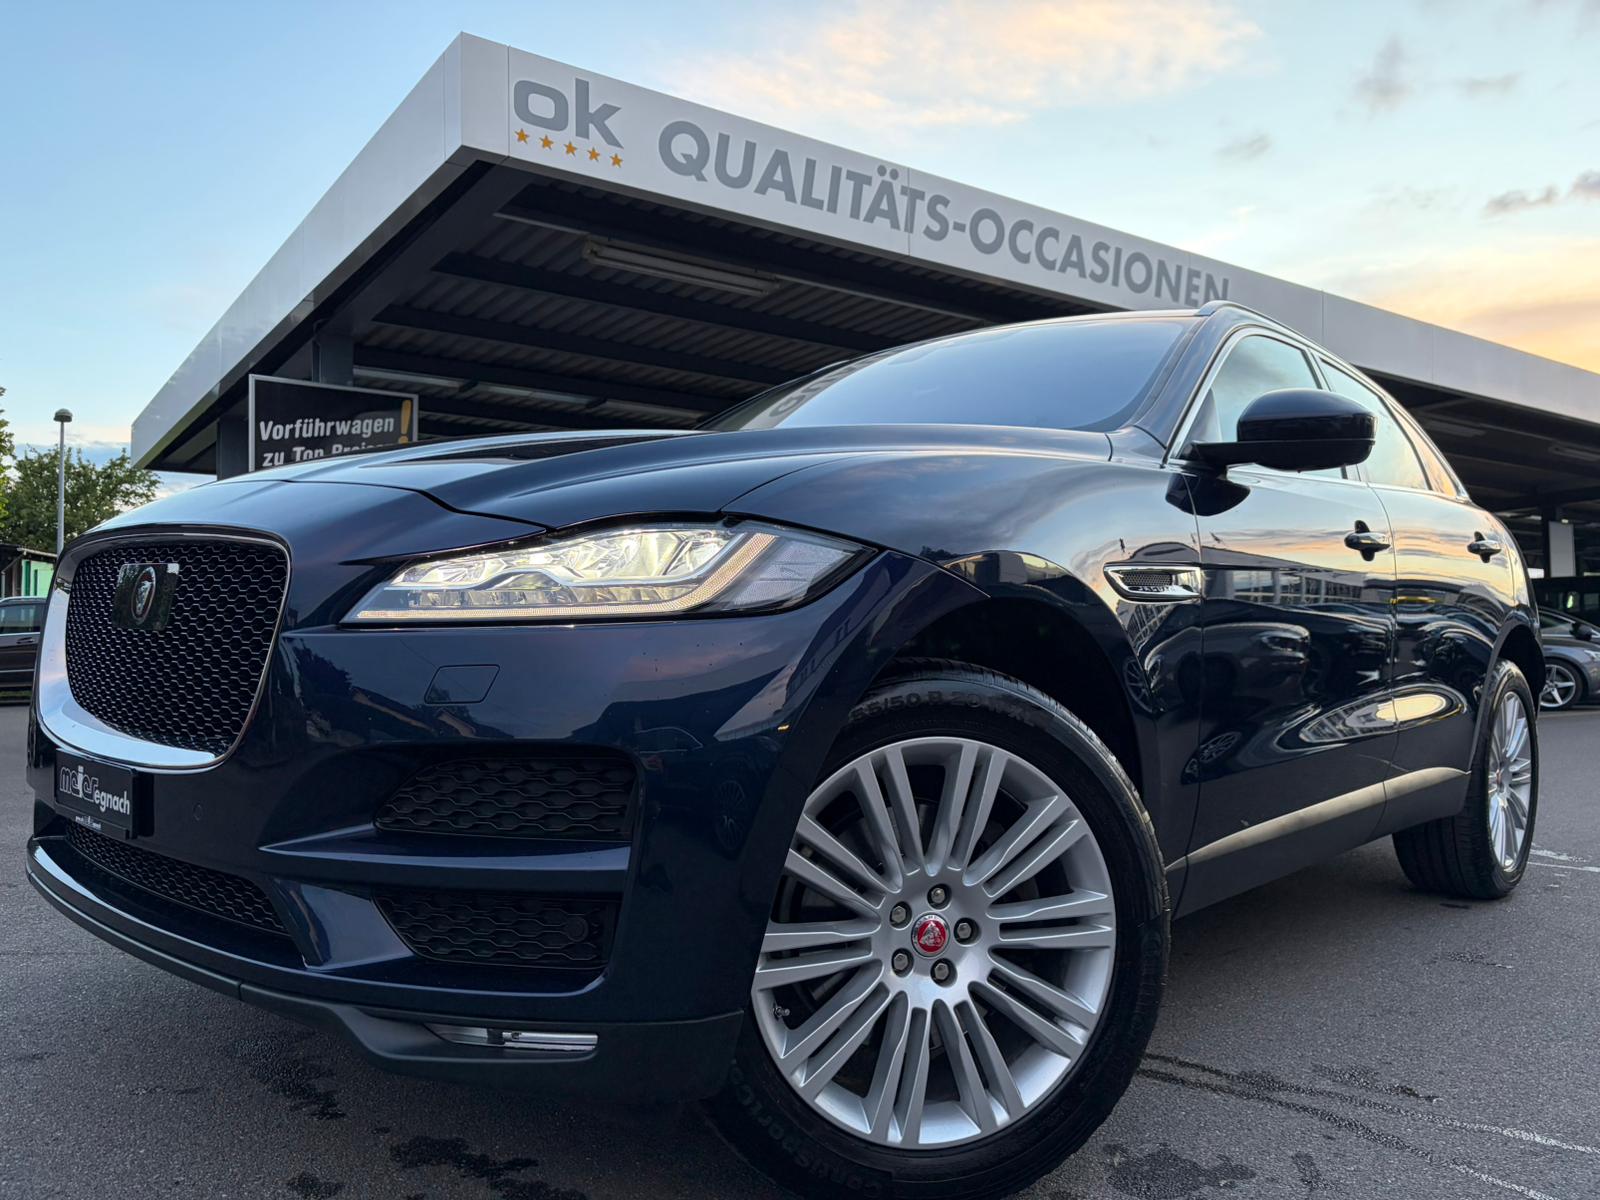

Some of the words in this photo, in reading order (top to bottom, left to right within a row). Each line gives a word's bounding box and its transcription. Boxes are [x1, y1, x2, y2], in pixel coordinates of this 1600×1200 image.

[513, 78, 624, 150] ok
[658, 120, 1229, 308] QUALITÄTS-OCCASIONEN
[259, 417, 395, 441] Vorführwagen
[262, 452, 285, 467] zu
